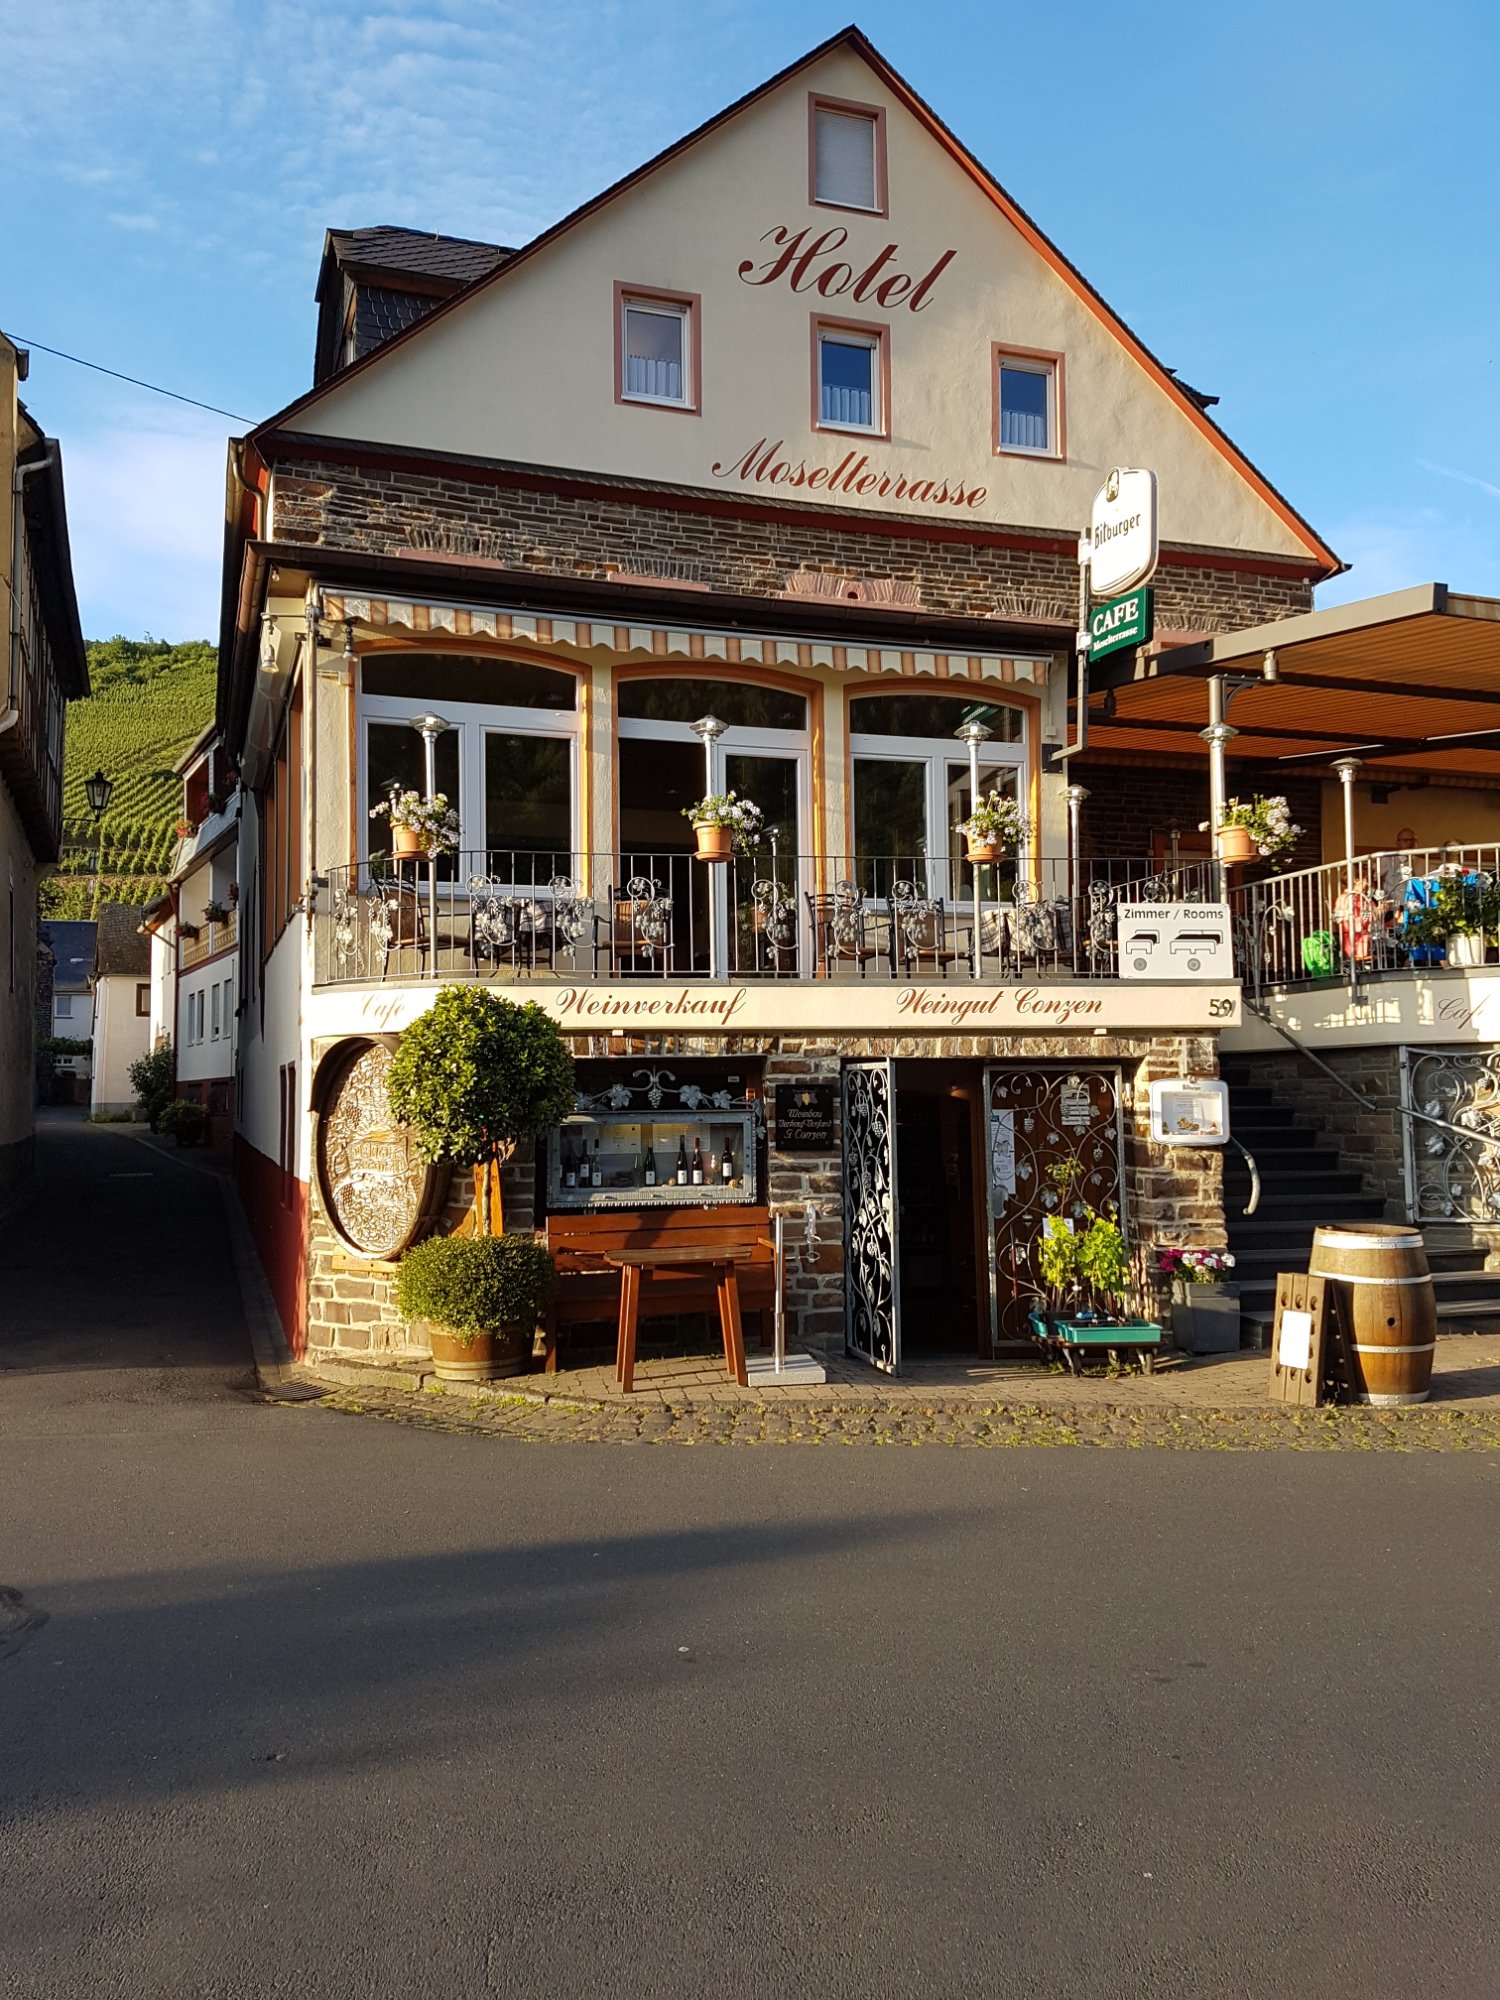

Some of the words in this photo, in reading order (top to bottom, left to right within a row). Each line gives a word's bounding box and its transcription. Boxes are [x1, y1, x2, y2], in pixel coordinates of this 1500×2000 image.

[738, 225, 958, 312] Hotel
[711, 437, 988, 509] Moselterrasse
[1095, 513, 1141, 550] Bitburger
[1093, 598, 1139, 636] CAFE
[1124, 908, 1171, 919] Zimmer
[1183, 909, 1224, 919] Rooms
[556, 988, 747, 1025] Weinverkauf
[897, 988, 1004, 1025] Weingut
[1014, 988, 1103, 1025] Conzen
[1208, 999, 1233, 1016] 59
[1438, 993, 1491, 1030] Caf
